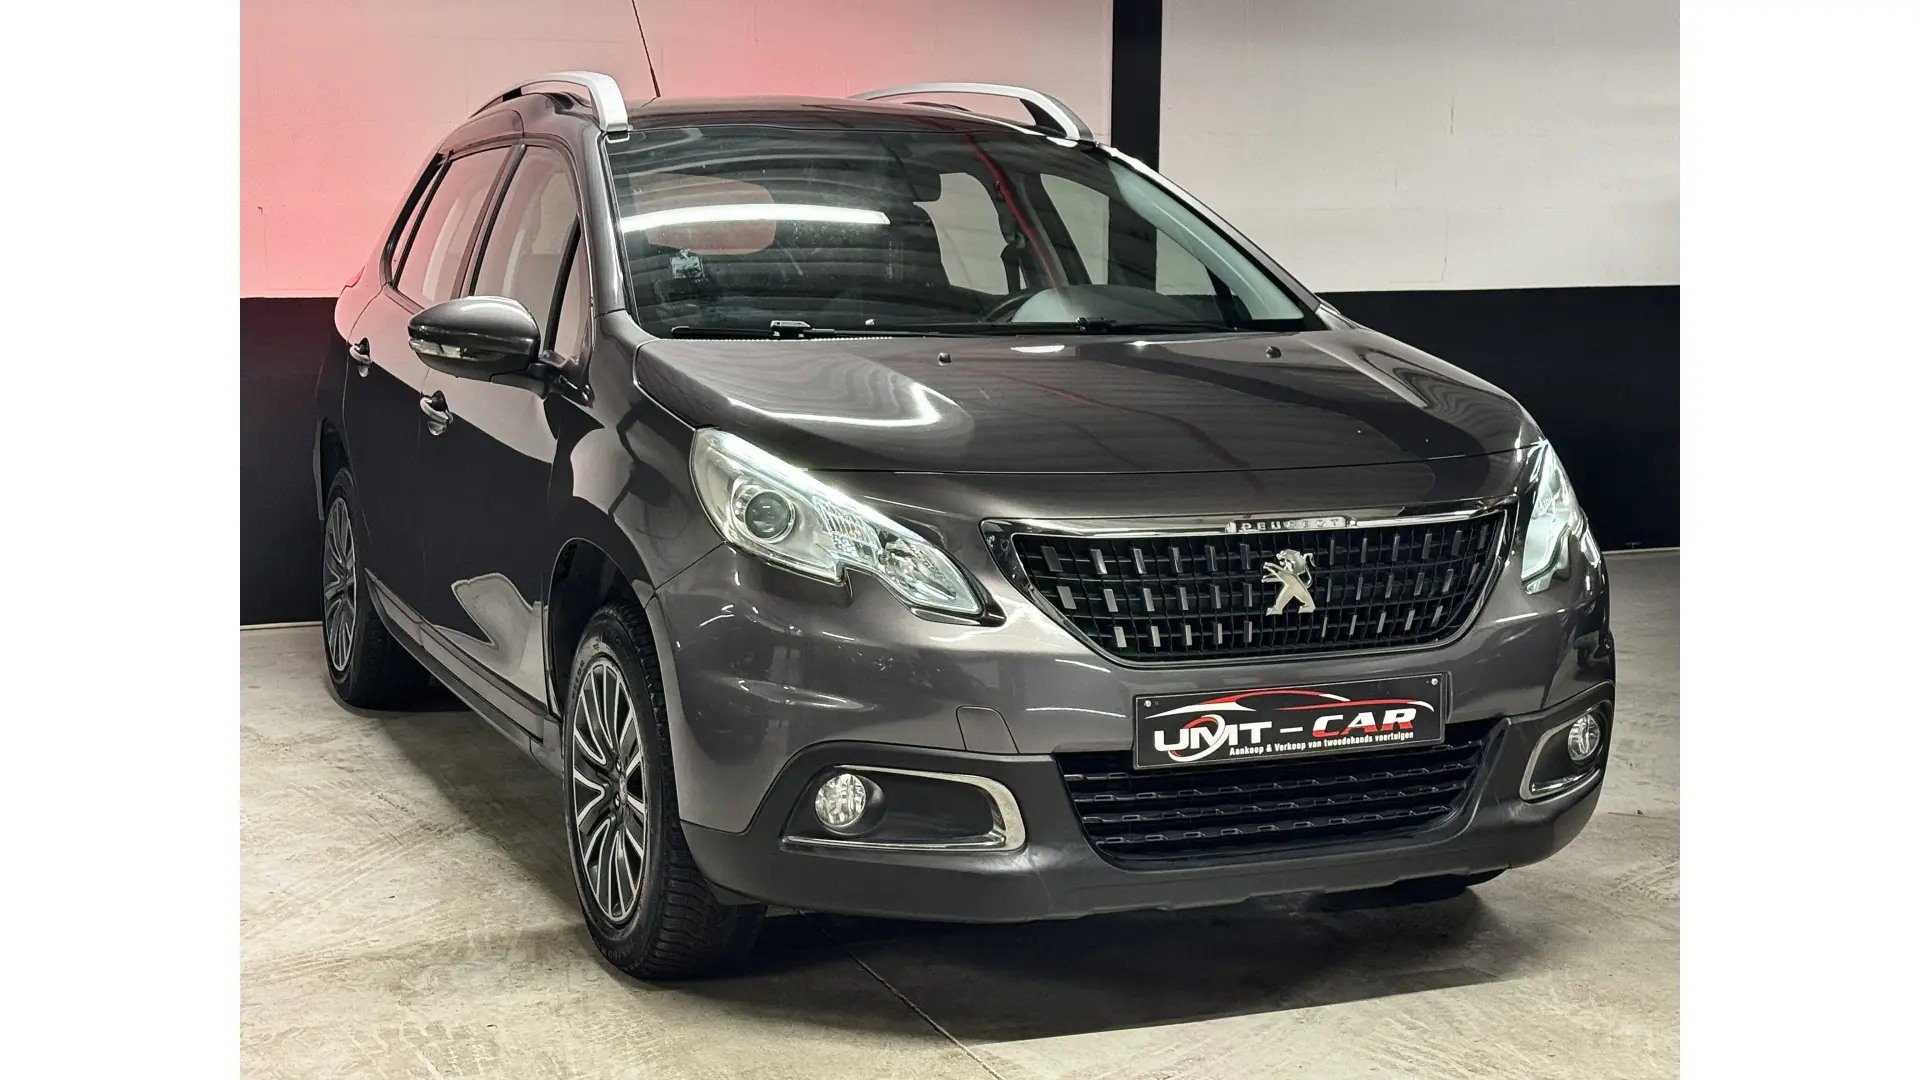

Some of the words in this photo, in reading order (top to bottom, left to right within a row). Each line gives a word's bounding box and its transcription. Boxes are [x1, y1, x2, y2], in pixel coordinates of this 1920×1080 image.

[1154, 721, 1272, 751] UMT
[1312, 708, 1416, 737] CAR
[1229, 745, 1264, 756] Aankoop
[1266, 744, 1273, 752] &
[1274, 742, 1306, 752] Verkoop
[1308, 740, 1322, 748] van
[1324, 735, 1373, 746] tweedehands
[1375, 731, 1414, 741] voertuigen
